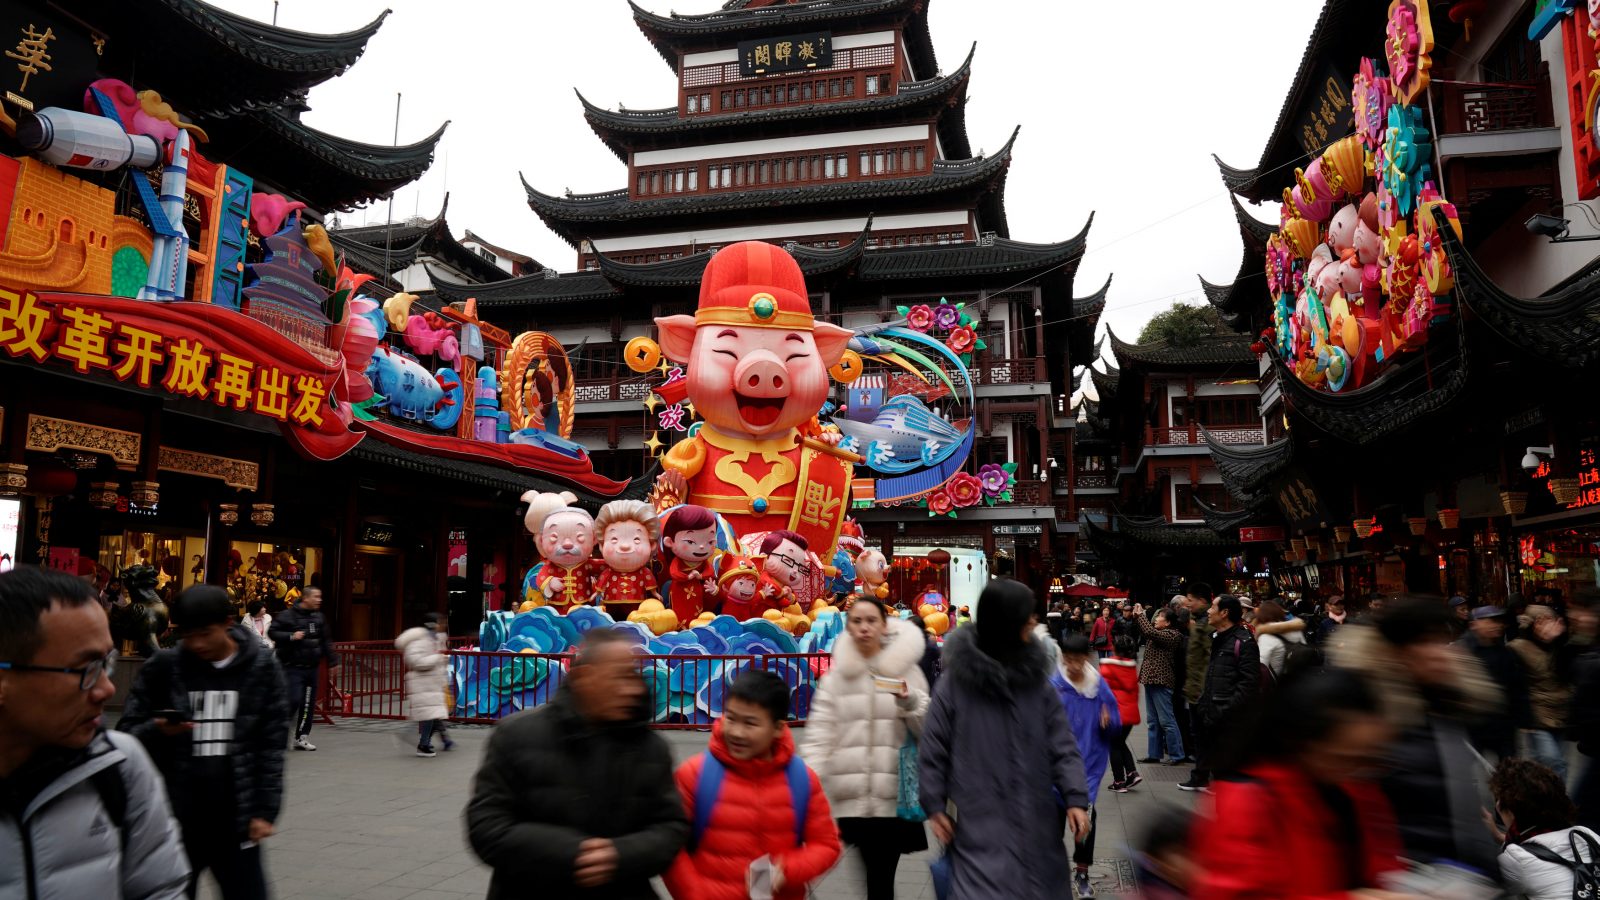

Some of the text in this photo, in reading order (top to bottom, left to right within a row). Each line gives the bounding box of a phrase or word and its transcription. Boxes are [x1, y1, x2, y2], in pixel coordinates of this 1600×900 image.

[0, 288, 325, 426] 改革开放再出发
[800, 479, 841, 530] 福
